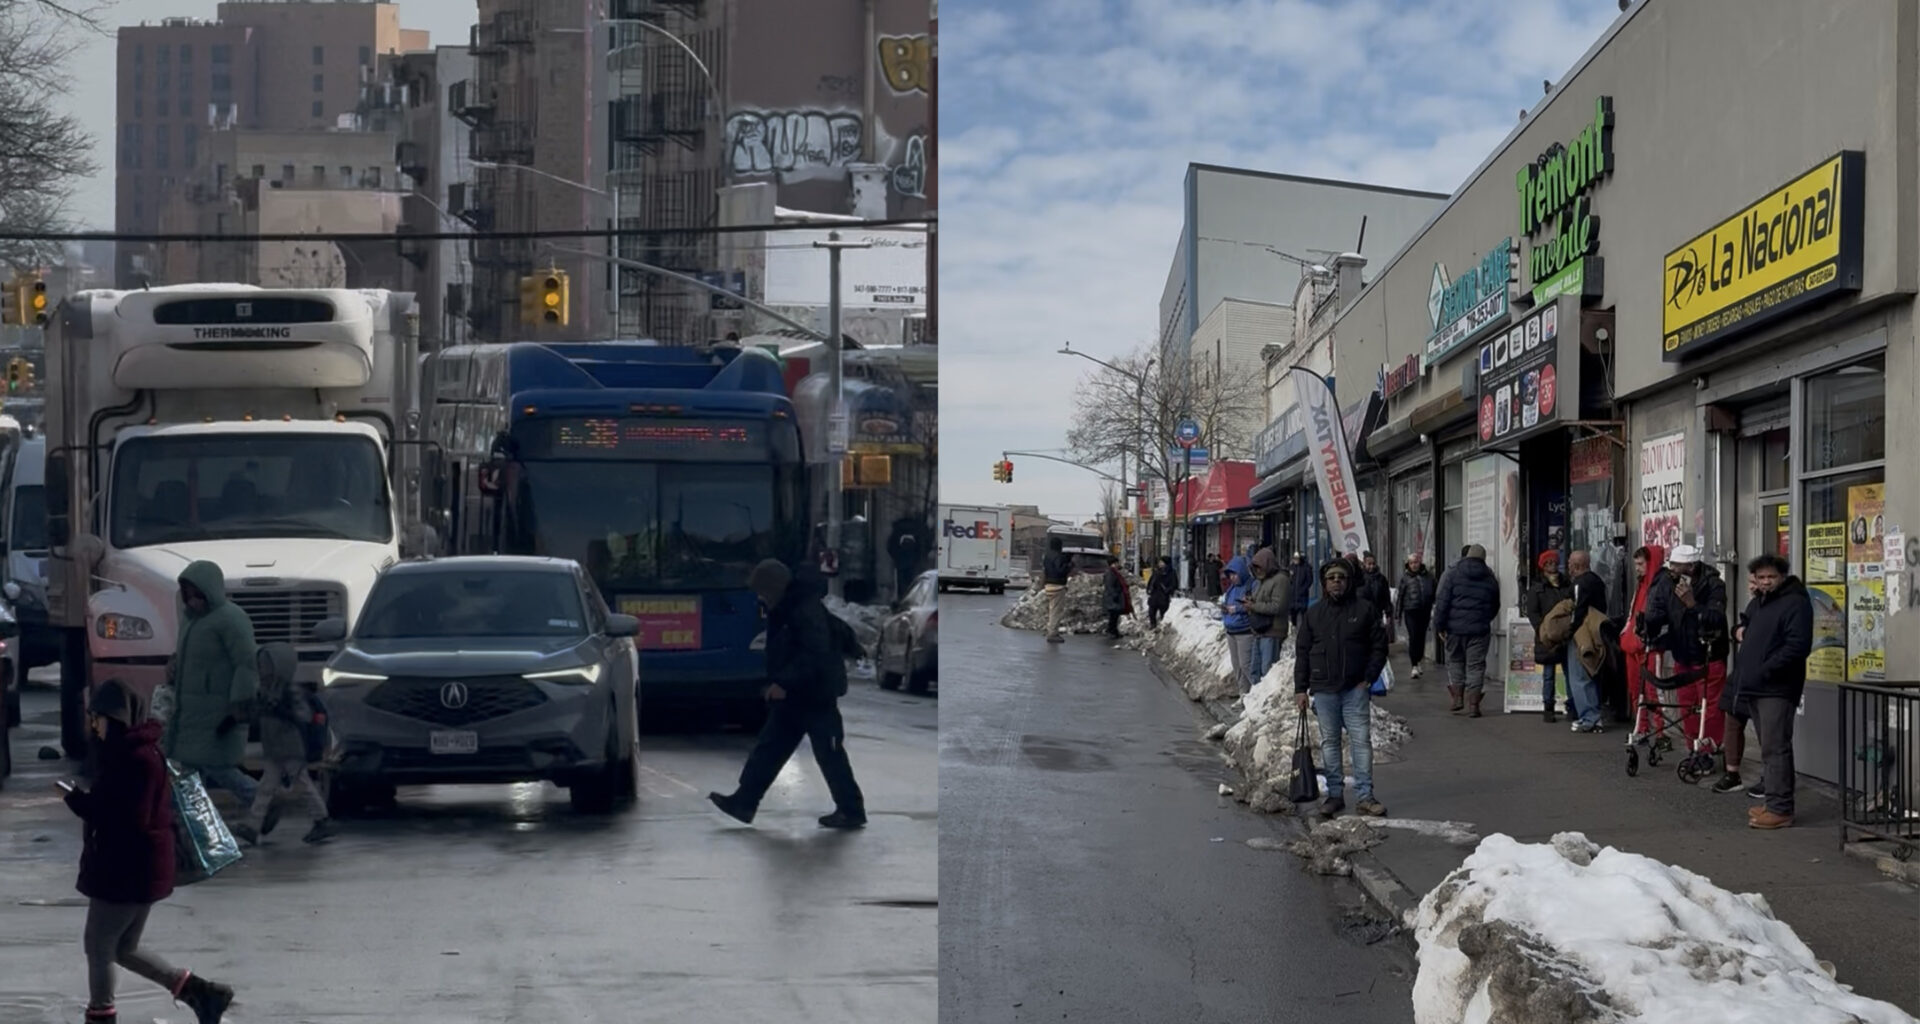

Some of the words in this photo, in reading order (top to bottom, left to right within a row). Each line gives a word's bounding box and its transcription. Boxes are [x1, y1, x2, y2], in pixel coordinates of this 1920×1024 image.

[1517, 96, 1605, 237] Tremont
[1530, 197, 1592, 282] mobile
[1710, 234, 1735, 292] La
[1738, 163, 1839, 280] Nacional
[1641, 443, 1664, 475] BLOW
[1666, 439, 1685, 470] OUT
[1642, 482, 1684, 514] SPEAKER
[943, 519, 1004, 540] FedEx
[1809, 548, 1825, 557] SOLD
[1825, 547, 1842, 556] HERE
[621, 601, 697, 614] MUSEUM
